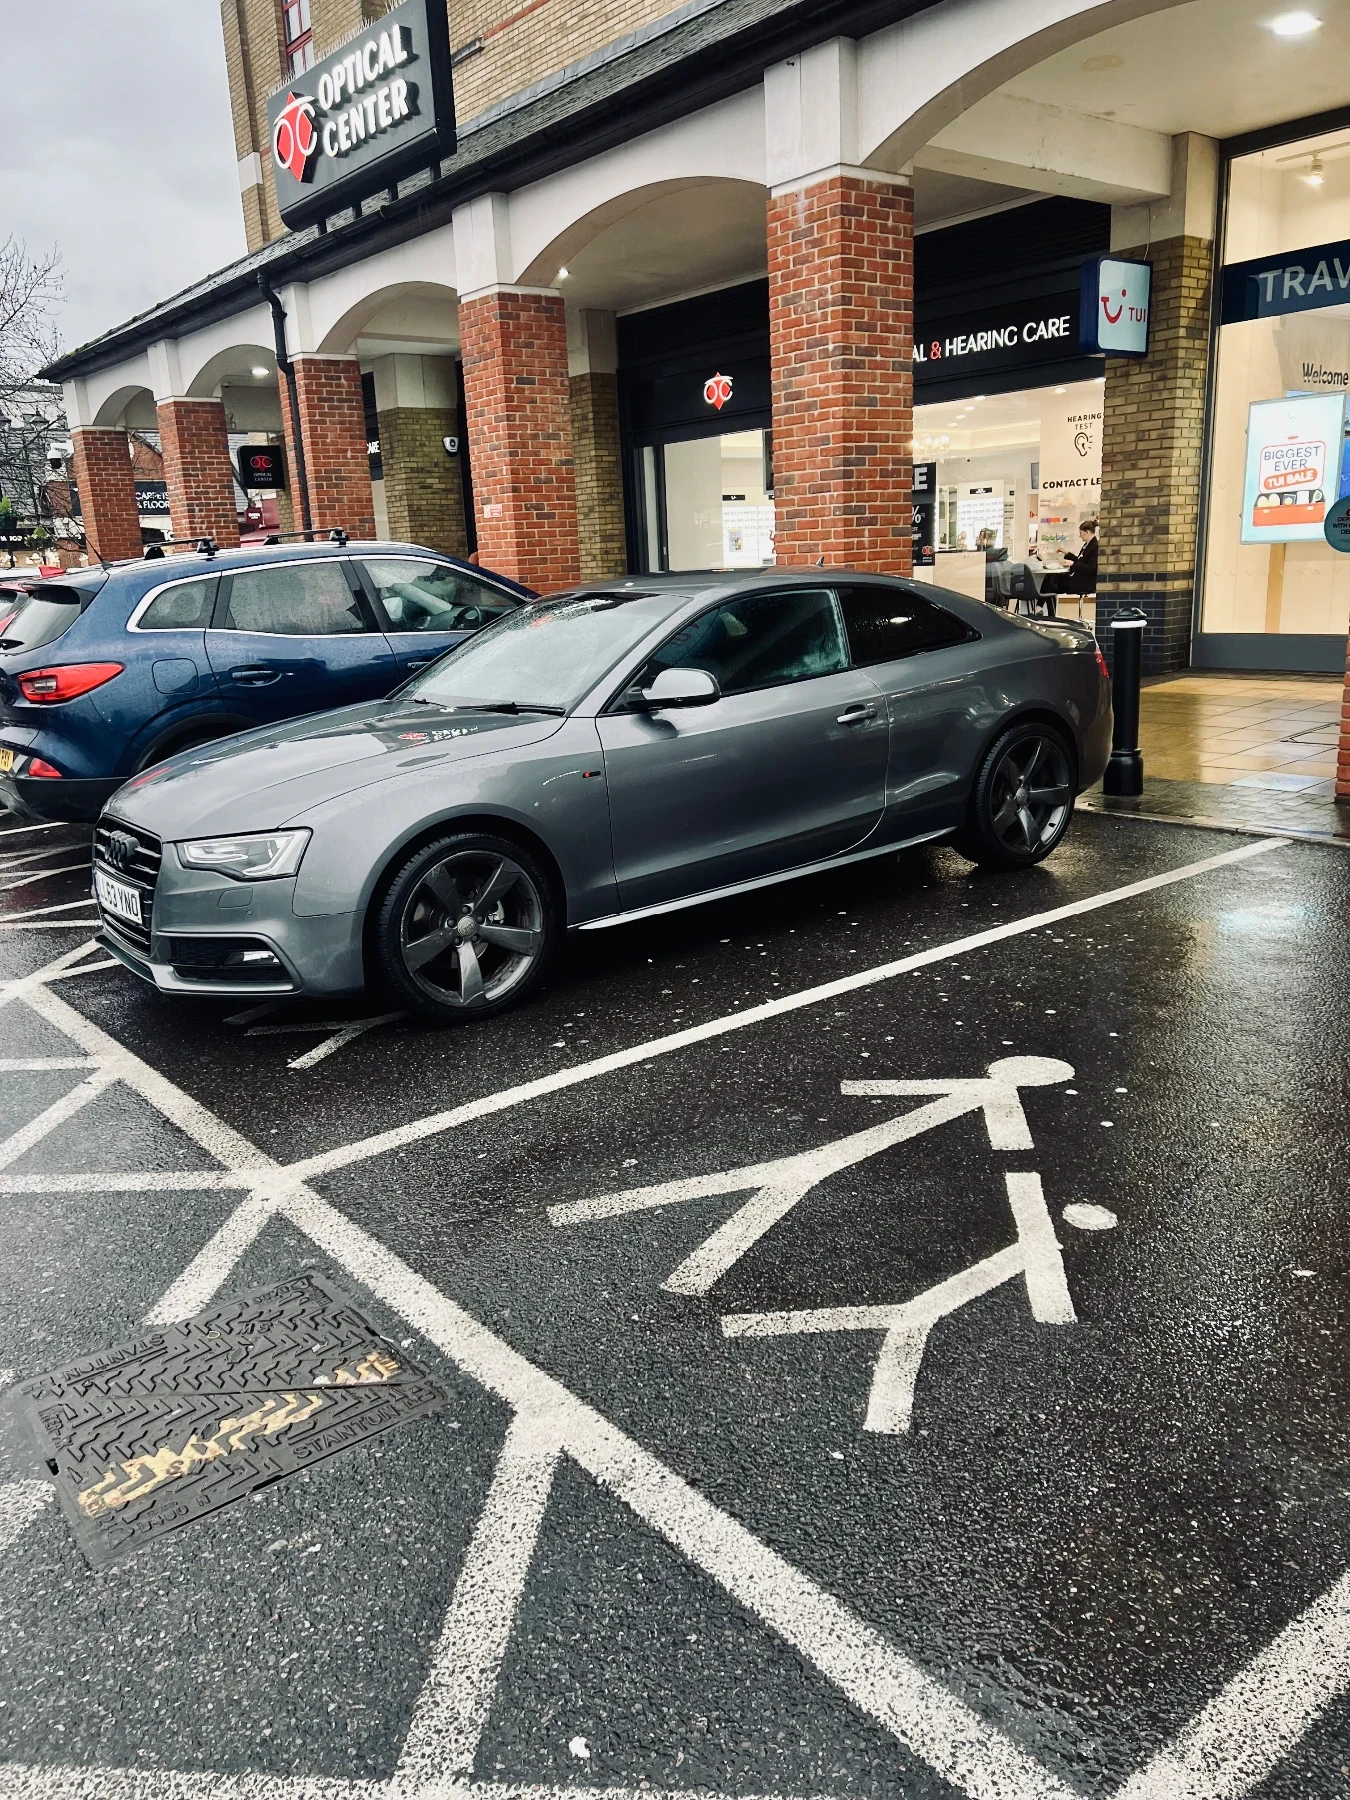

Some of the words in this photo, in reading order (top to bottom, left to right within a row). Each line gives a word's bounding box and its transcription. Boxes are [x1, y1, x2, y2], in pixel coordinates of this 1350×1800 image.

[318, 23, 408, 111] OPTICAL
[322, 79, 409, 157] CENTER
[1128, 306, 1146, 323] TUI
[930, 341, 942, 360] &
[945, 326, 1018, 357] HEARING
[1023, 315, 1070, 343] CARE
[1302, 362, 1349, 386] Welcome
[1067, 412, 1102, 423] HEARING
[1075, 422, 1093, 430] TEST
[1264, 446, 1321, 460] BIGGEST
[1274, 459, 1308, 471] EVER
[1042, 478, 1088, 490] CONTACT
[1267, 475, 1286, 488] TUI
[61, 1333, 166, 1381] STANTON
[293, 1404, 402, 1460] STANTON
